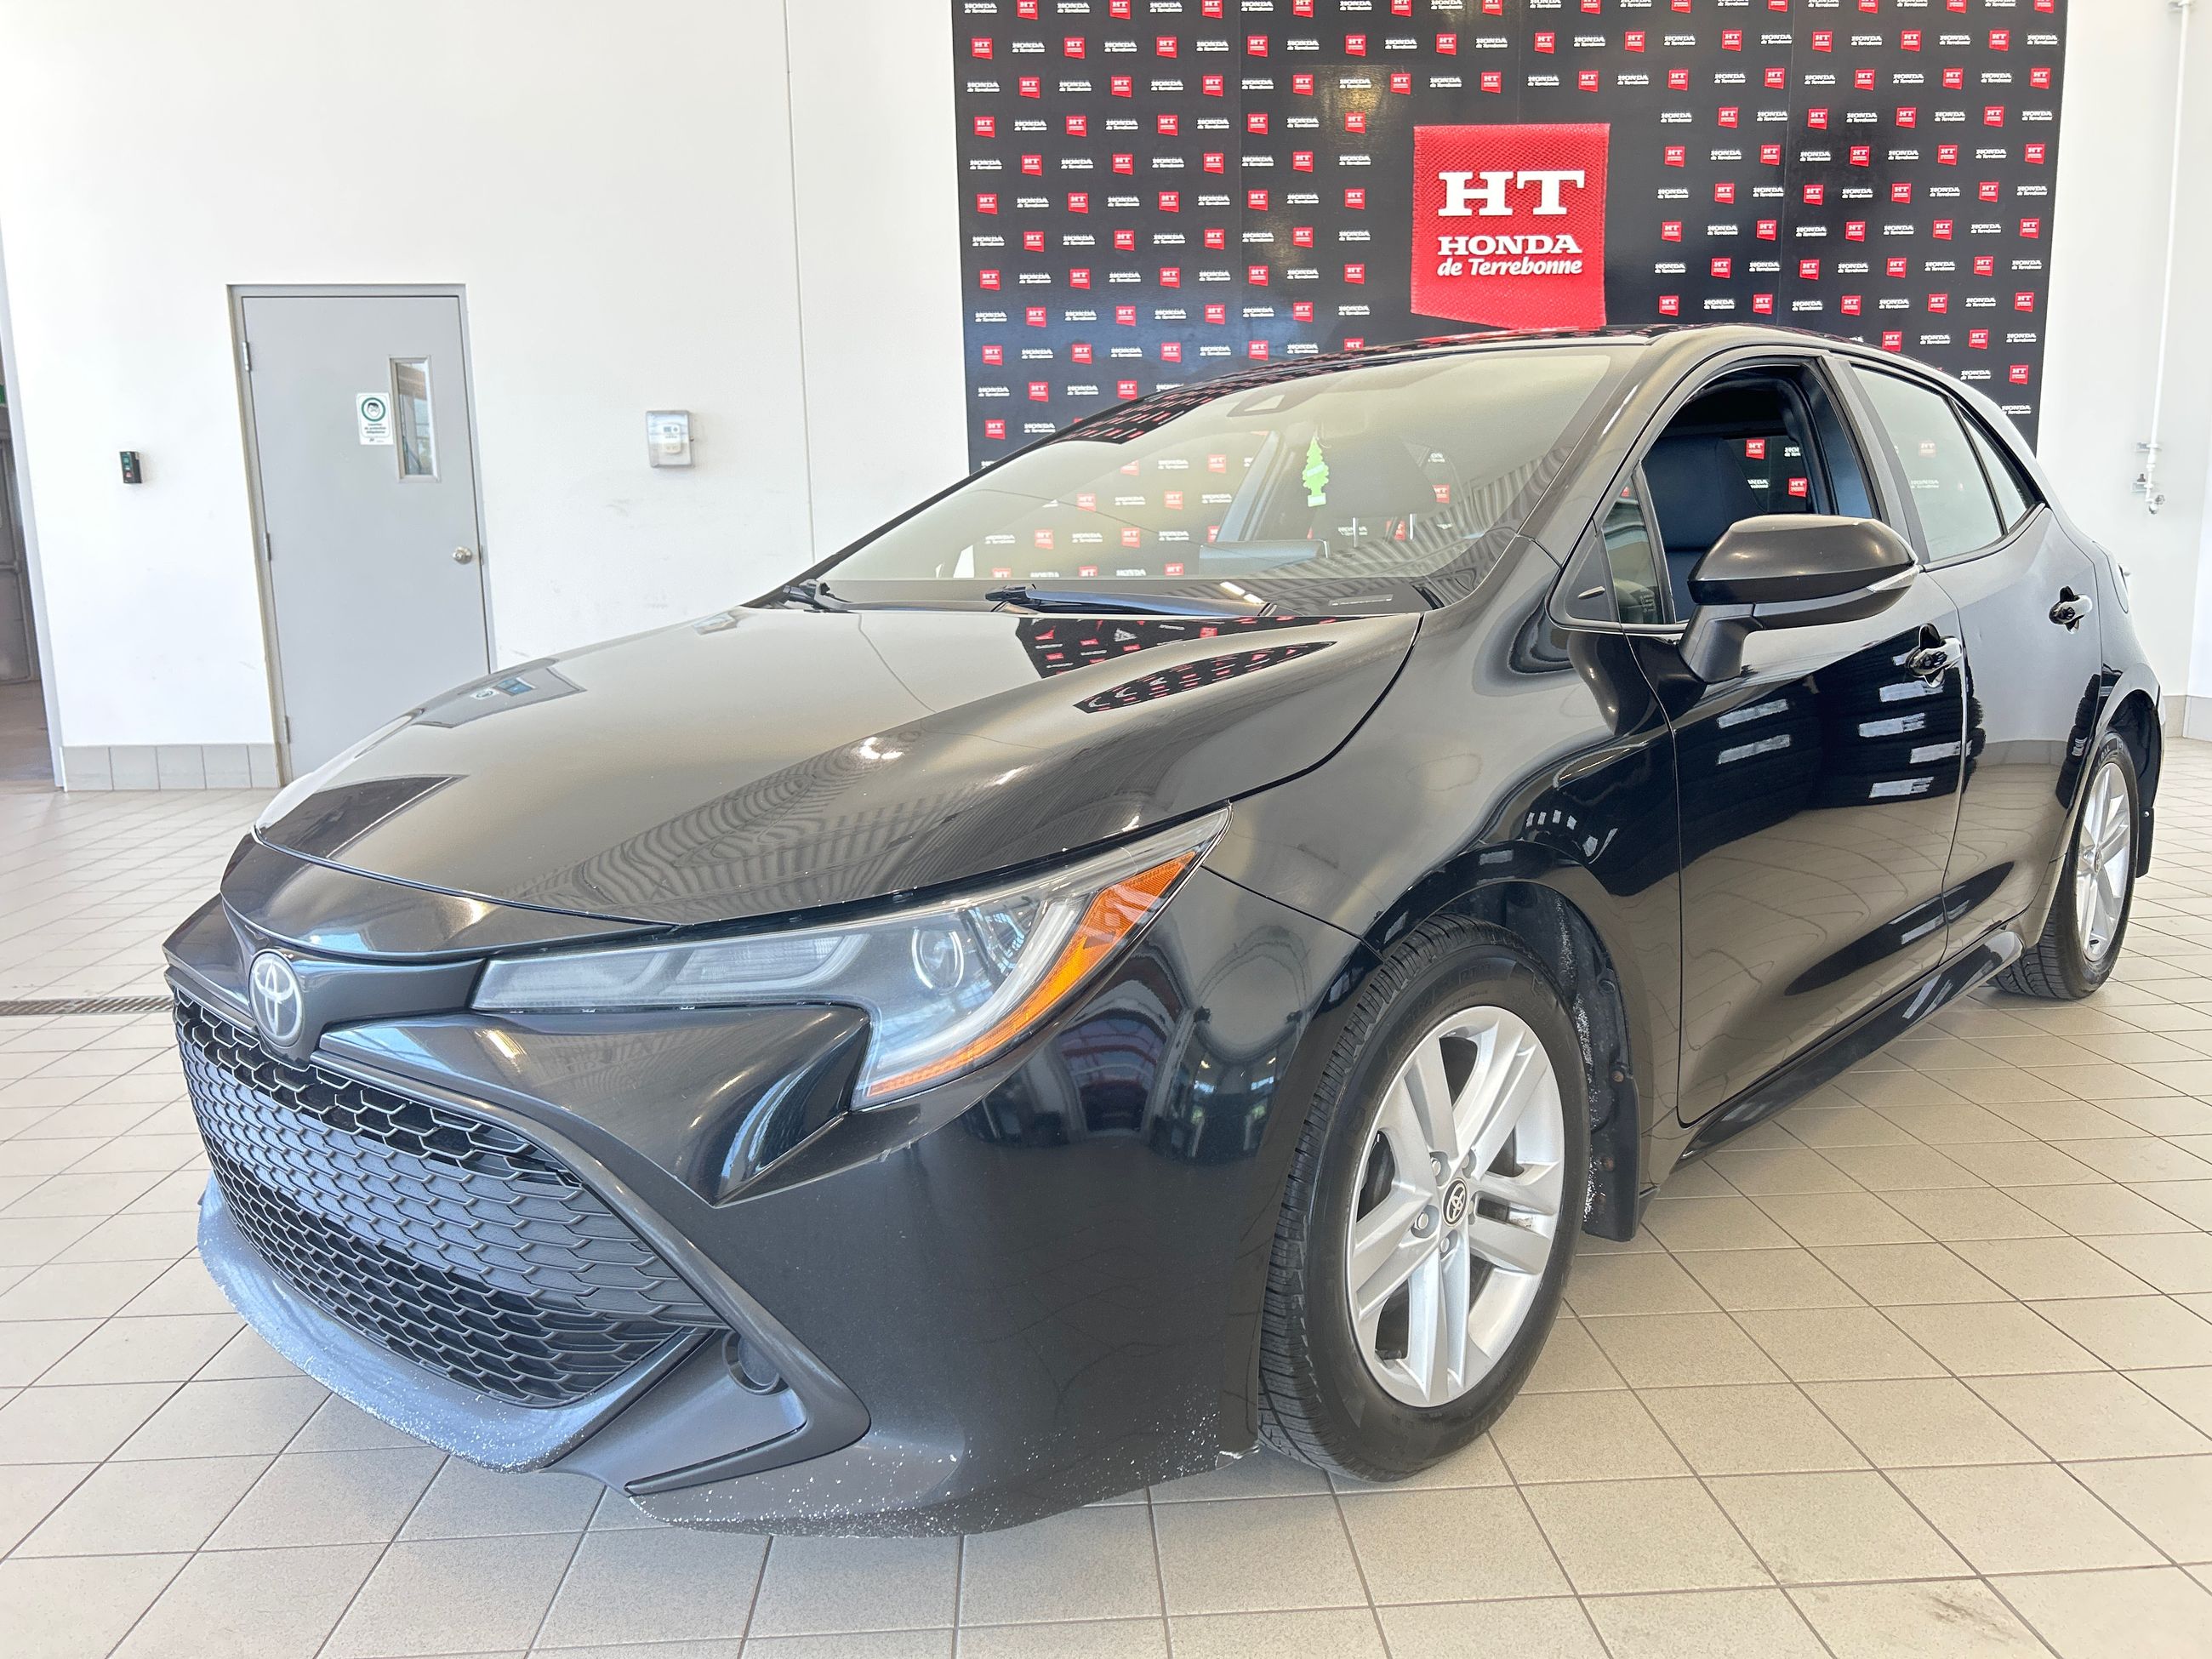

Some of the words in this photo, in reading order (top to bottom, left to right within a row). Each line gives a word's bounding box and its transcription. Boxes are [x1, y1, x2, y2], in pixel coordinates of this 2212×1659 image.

[1438, 169, 1586, 217] HT
[1437, 234, 1583, 255] HONDA
[1437, 258, 1463, 276] de
[1468, 257, 1583, 276] Terrebonne
